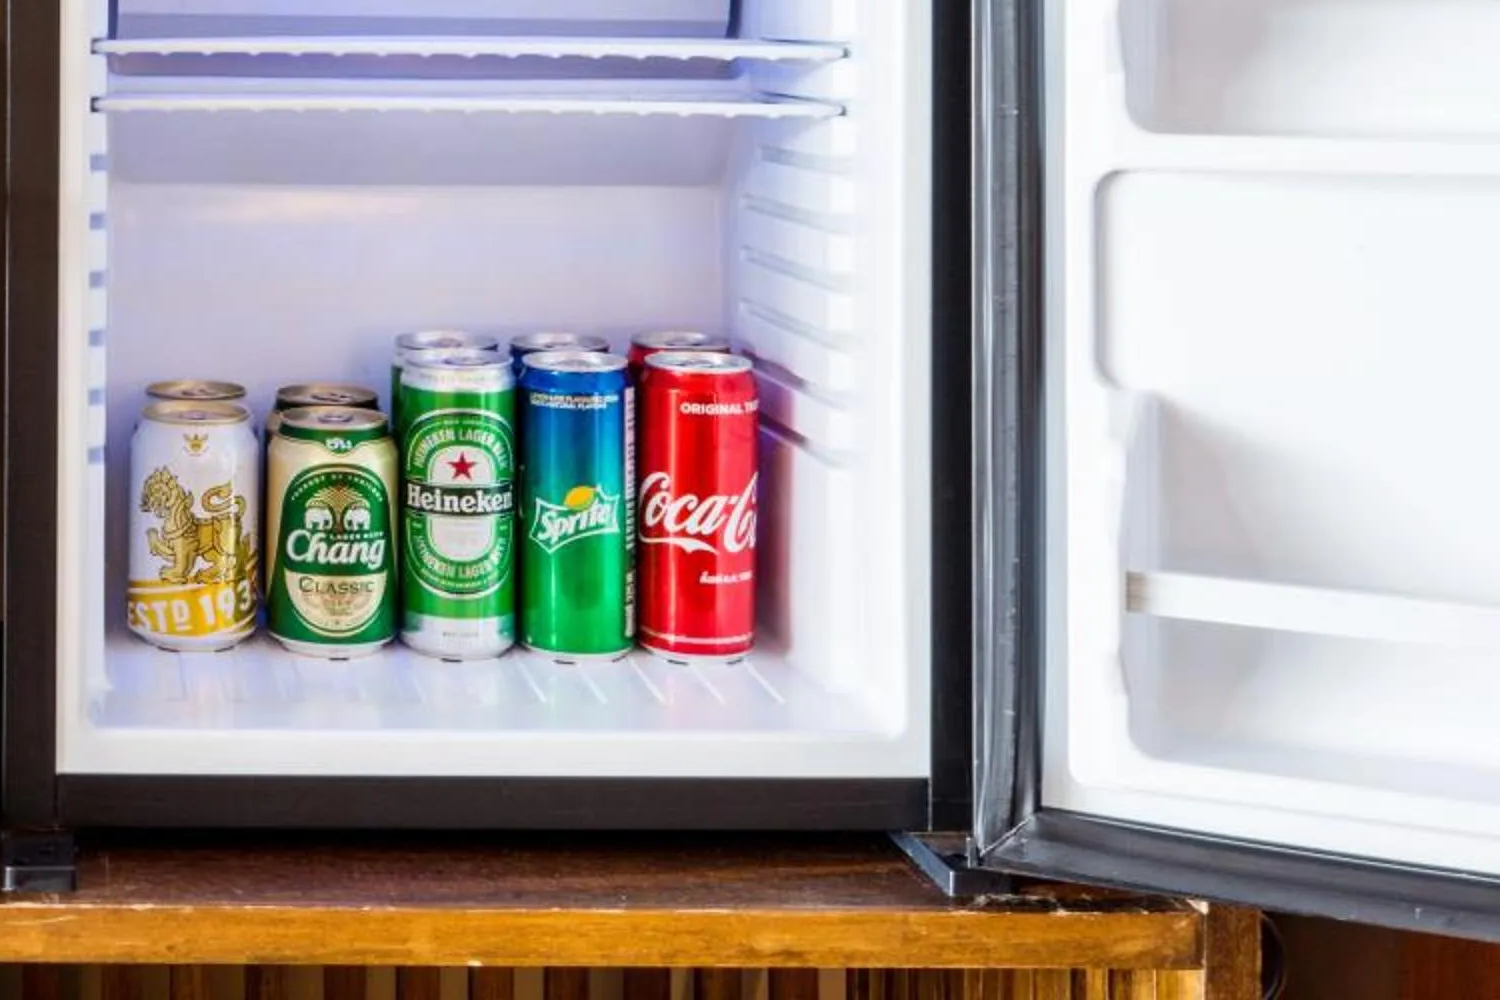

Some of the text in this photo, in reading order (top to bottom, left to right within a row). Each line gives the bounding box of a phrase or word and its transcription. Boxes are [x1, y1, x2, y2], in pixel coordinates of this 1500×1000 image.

[680, 402, 743, 415] ORIGINAL
[536, 498, 613, 545] Sprite
[286, 529, 386, 570] Chang
[200, 579, 256, 625] 193
